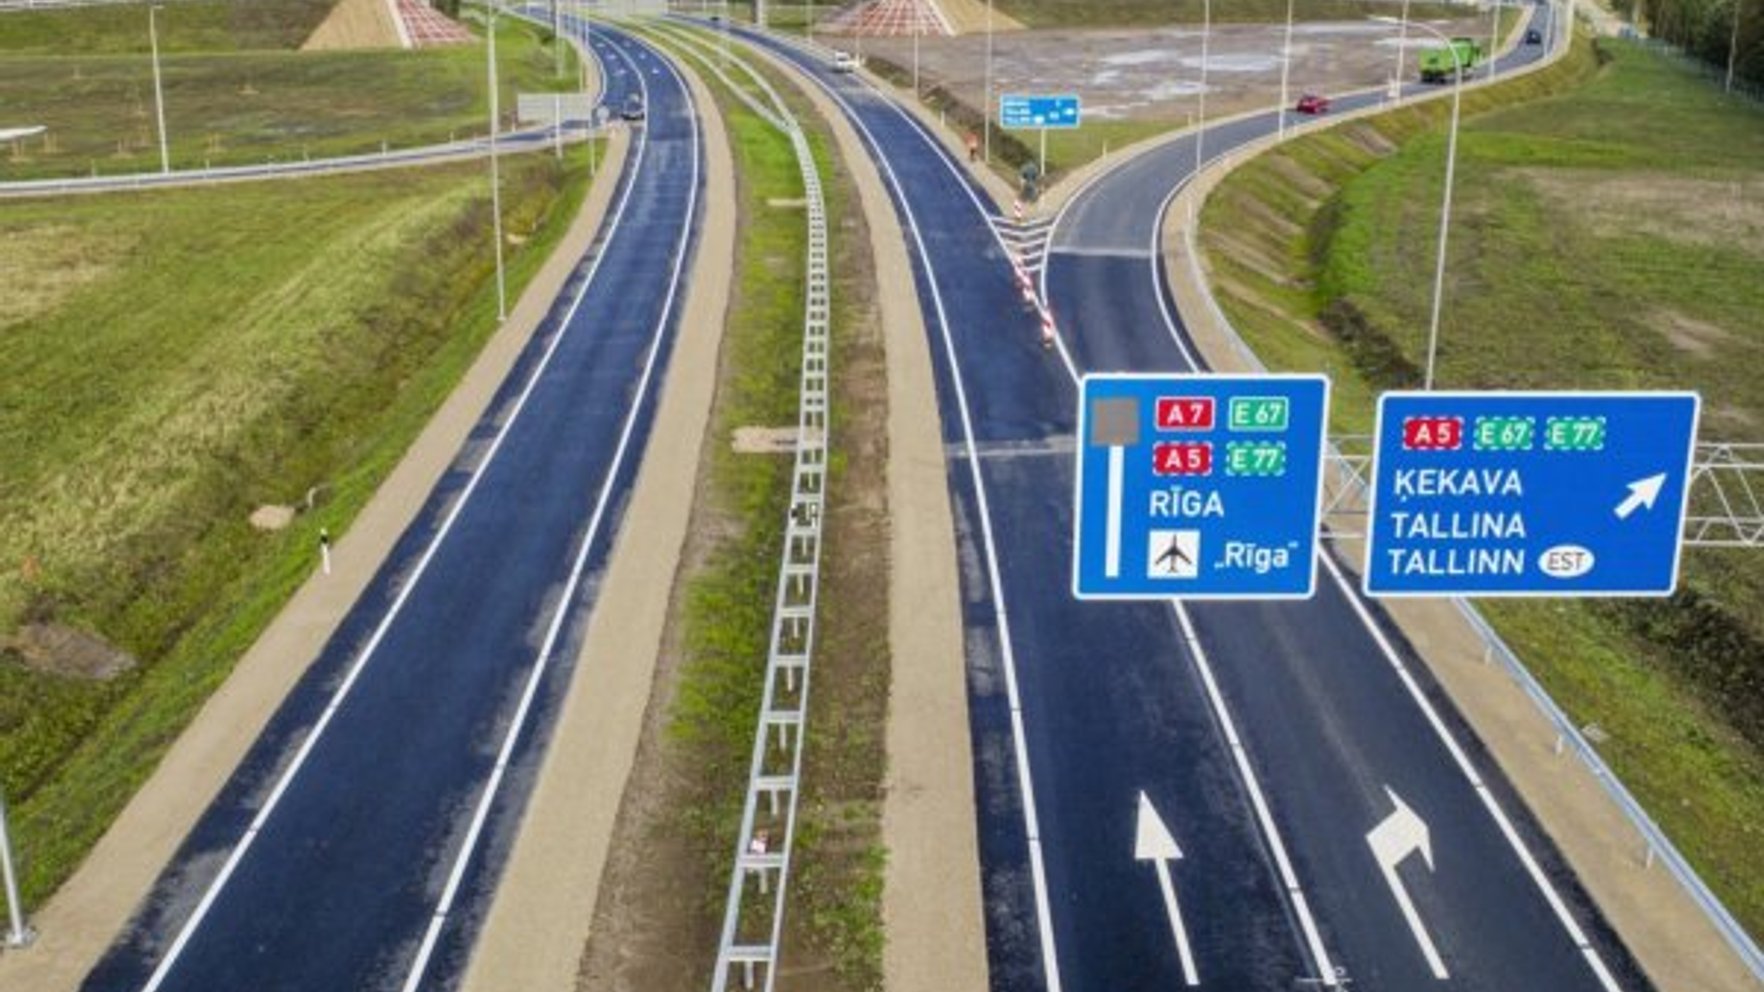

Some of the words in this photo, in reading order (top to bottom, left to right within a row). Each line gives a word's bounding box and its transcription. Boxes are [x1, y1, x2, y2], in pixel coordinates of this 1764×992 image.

[1395, 470, 1522, 501] ĶEKAVA
[1150, 486, 1224, 517] RĪGA
[1392, 513, 1526, 538] TALLINA
[1388, 549, 1524, 574] TALLINN
[1547, 551, 1585, 571] EST
